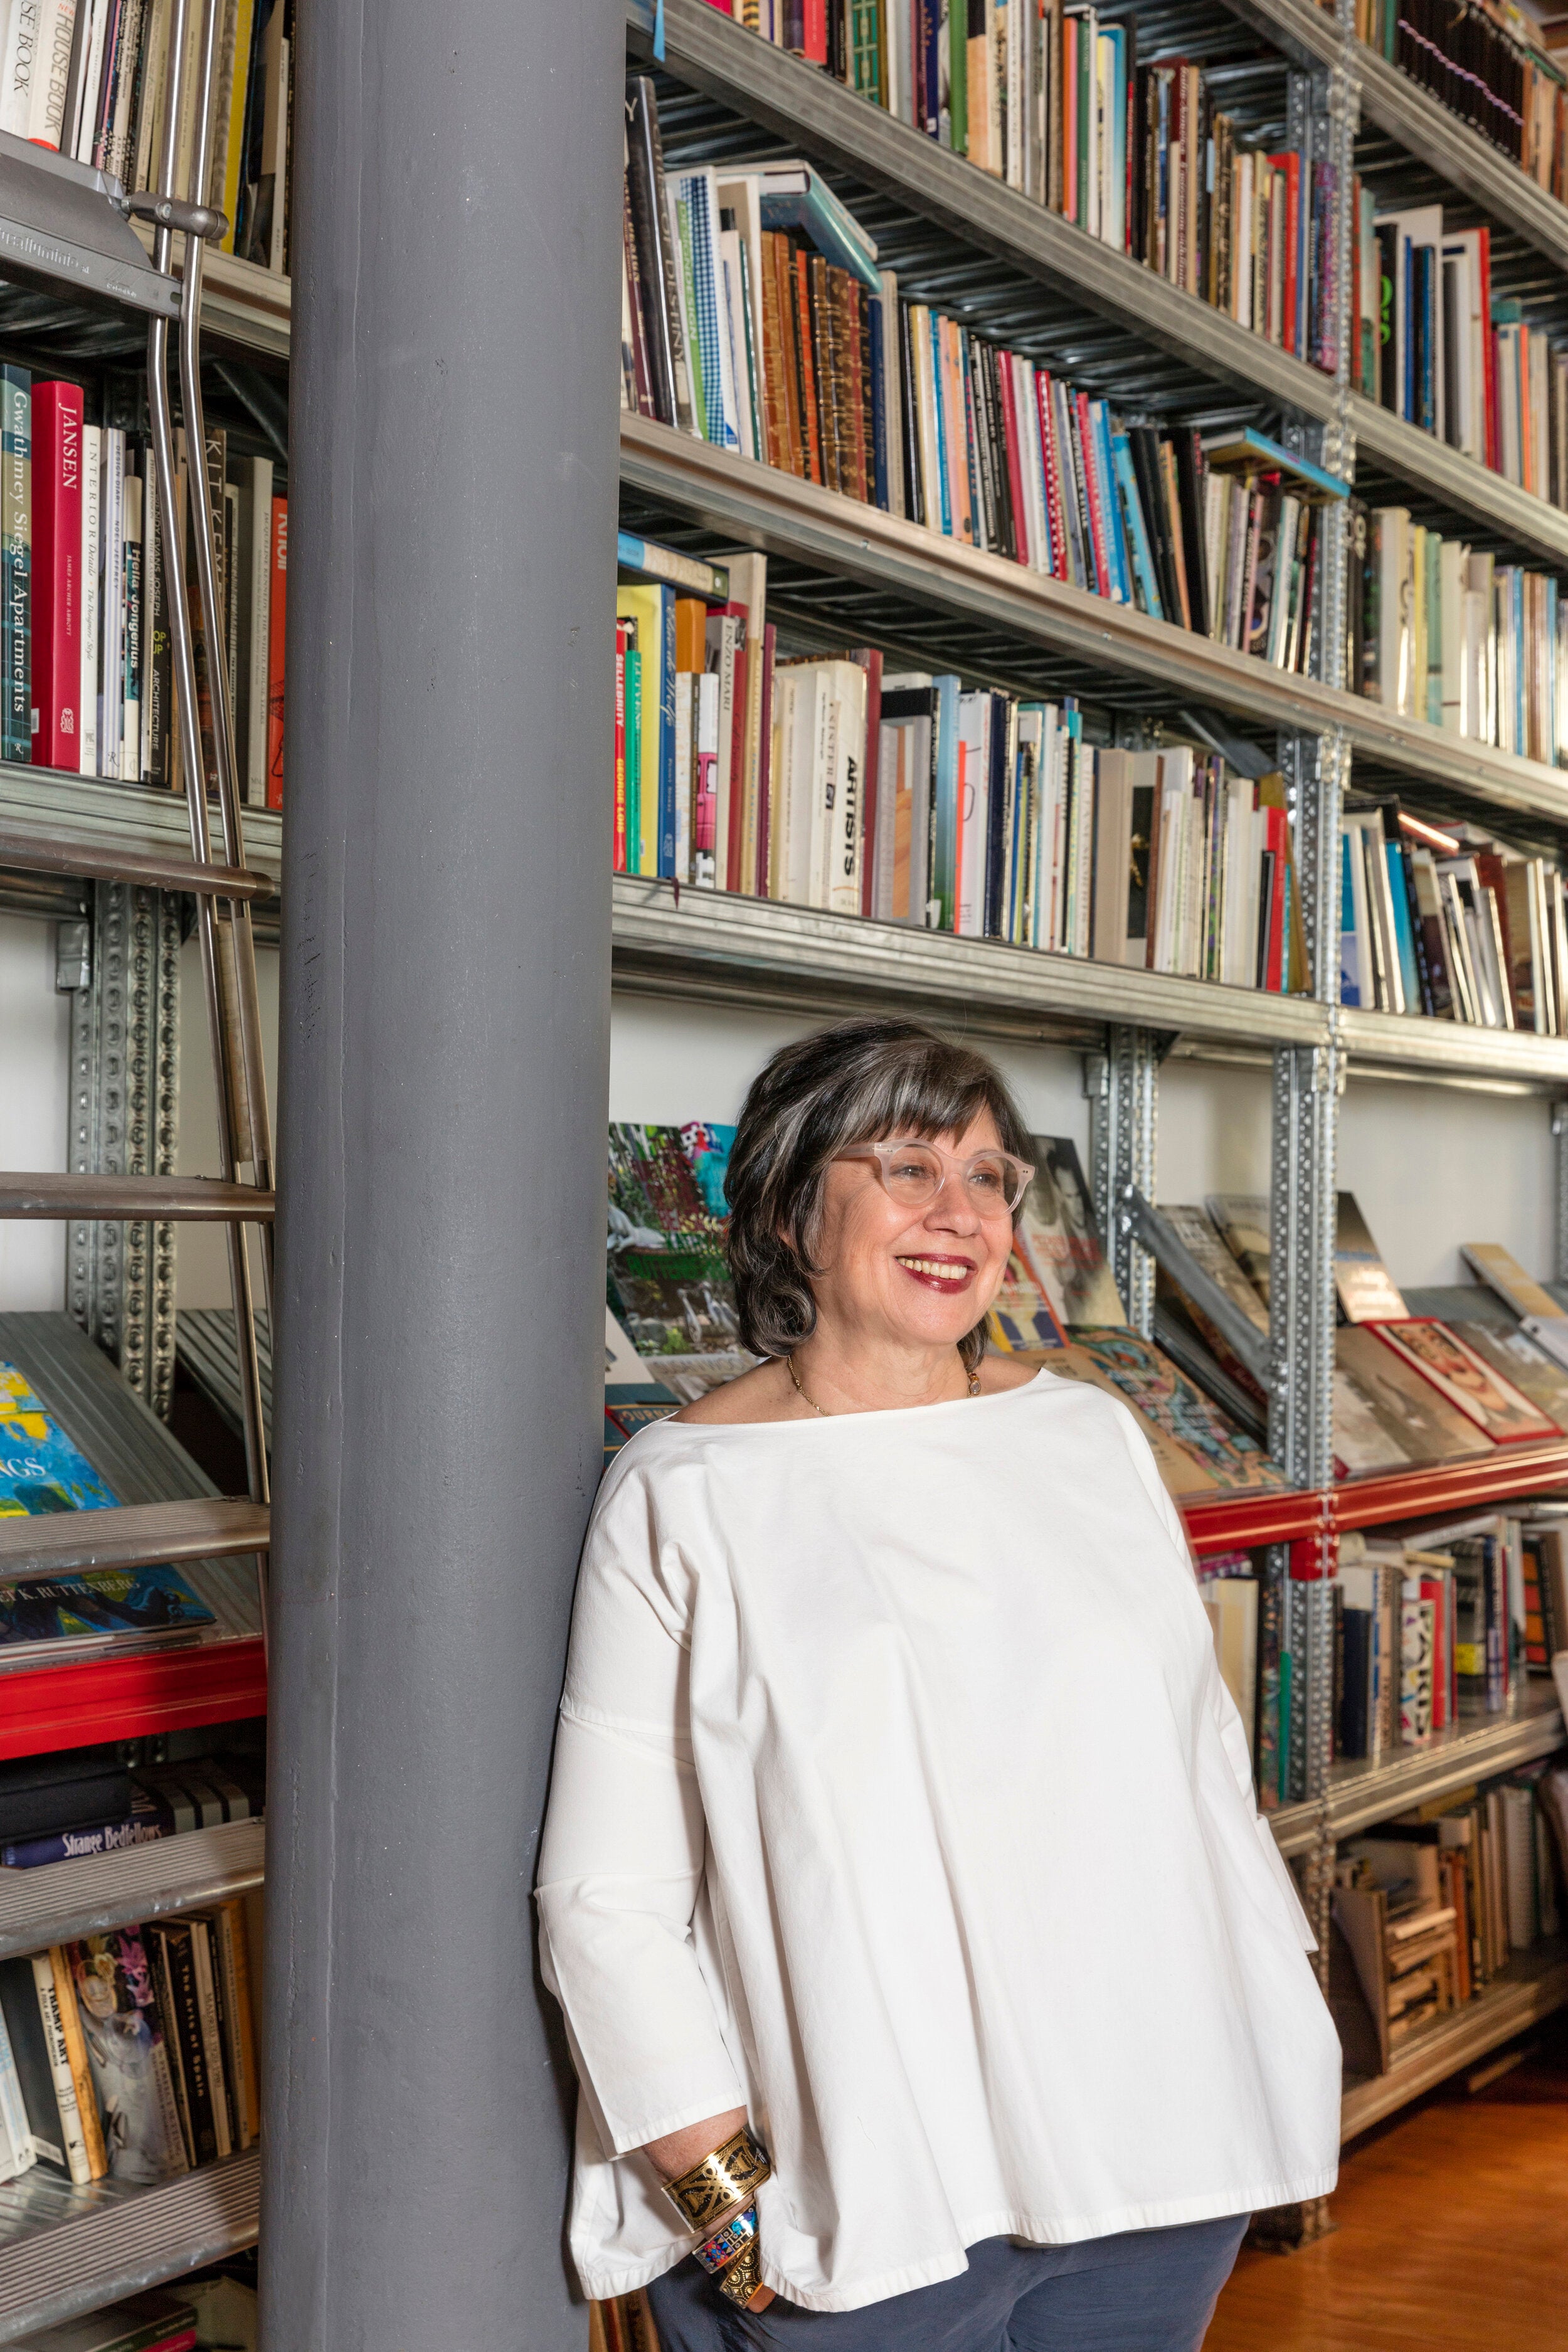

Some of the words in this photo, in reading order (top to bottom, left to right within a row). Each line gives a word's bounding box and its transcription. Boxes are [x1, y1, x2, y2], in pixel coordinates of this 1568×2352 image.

[14, 33, 33, 97] BOOK
[51, 13, 72, 78] HOUSE
[45, 78, 65, 136] BOOK
[665, 259, 684, 364] DESTINY
[9, 391, 28, 504] Gwathmey
[58, 403, 77, 489] JANSEN
[205, 439, 222, 494] KIT
[88, 442, 97, 538] INTERIOR
[9, 511, 28, 576] Siegel
[88, 543, 97, 576] Details
[132, 549, 140, 588] Hella
[9, 584, 28, 712] Apartments
[128, 594, 140, 669] Jongerius
[153, 630, 166, 642] OP
[724, 625, 733, 667] ENZO
[152, 669, 161, 750] ARCHITECTURE
[845, 756, 857, 876] ARTISTS
[36, 1578, 140, 1598] RUTTENBERG
[62, 1832, 103, 1857] Strange
[104, 1821, 163, 1850] Bedfellows
[181, 1965, 190, 1992] The
[48, 1985, 62, 2033] TRAMP
[56, 2038, 68, 2065] ART
[186, 1998, 195, 2030] Arts
[190, 2034, 199, 2048] of
[193, 2056, 204, 2097] Spain
